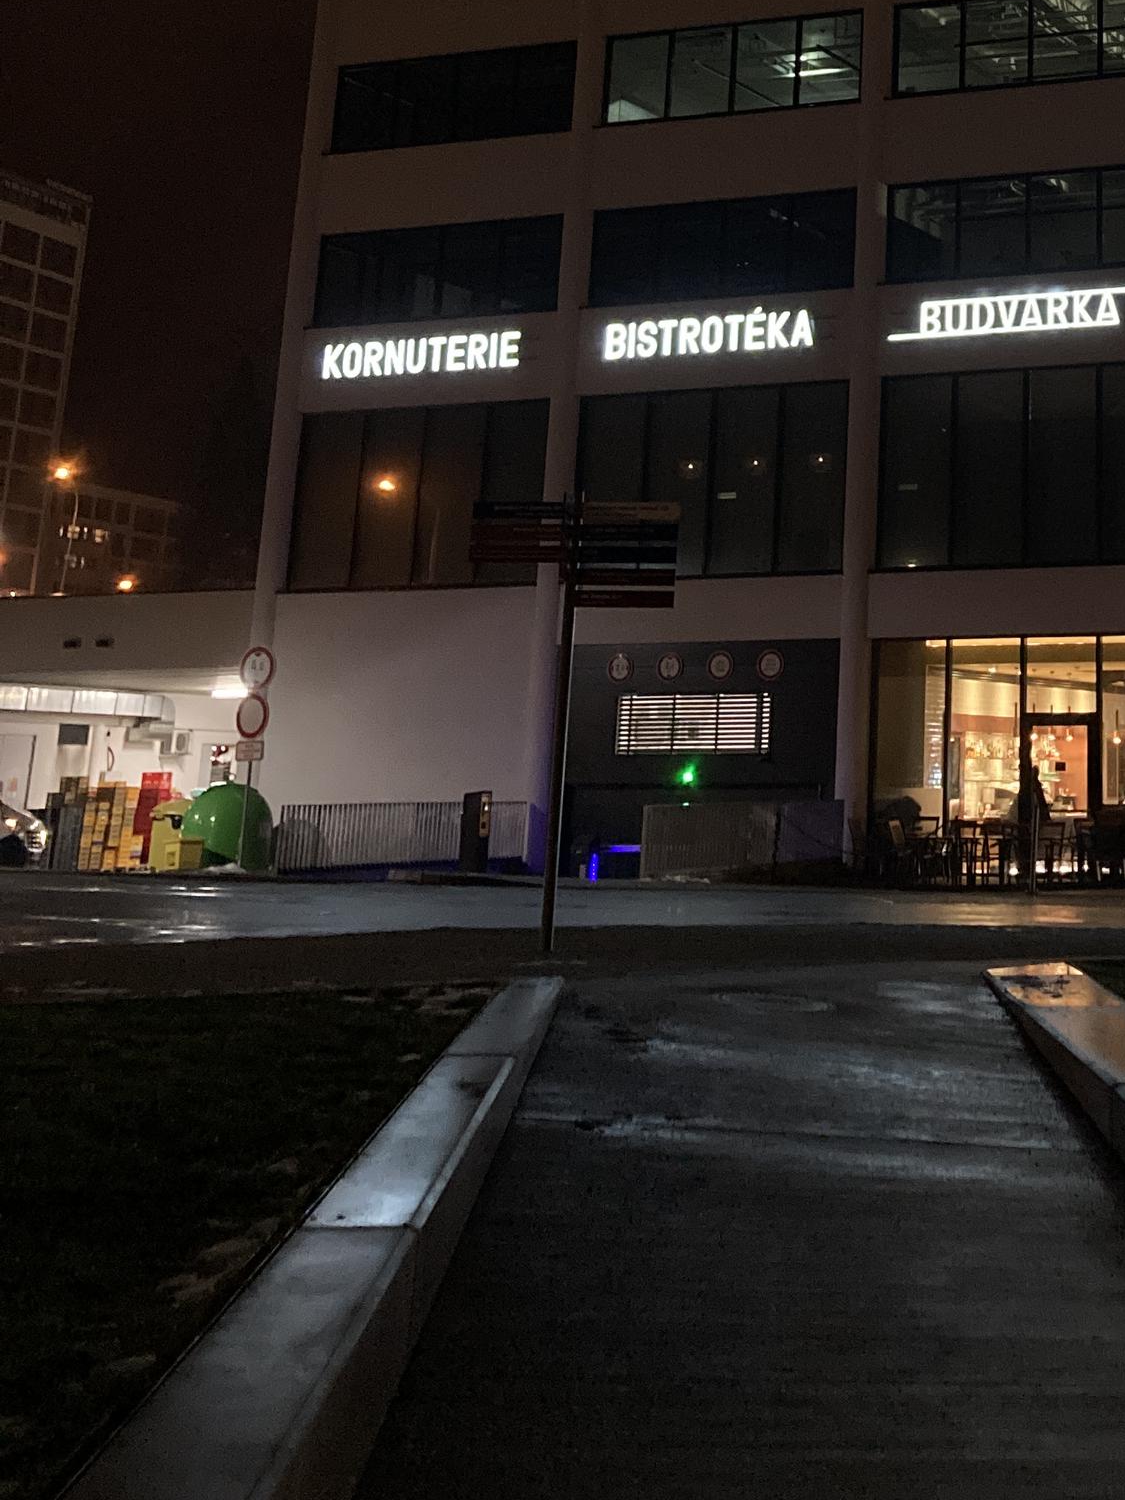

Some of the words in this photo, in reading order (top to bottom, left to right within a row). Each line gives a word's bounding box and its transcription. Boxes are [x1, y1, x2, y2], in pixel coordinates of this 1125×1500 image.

[602, 306, 815, 361] BISTROTÉKA
[919, 291, 1121, 335] BUDVARKA
[321, 330, 522, 380] KORNUTERIE
